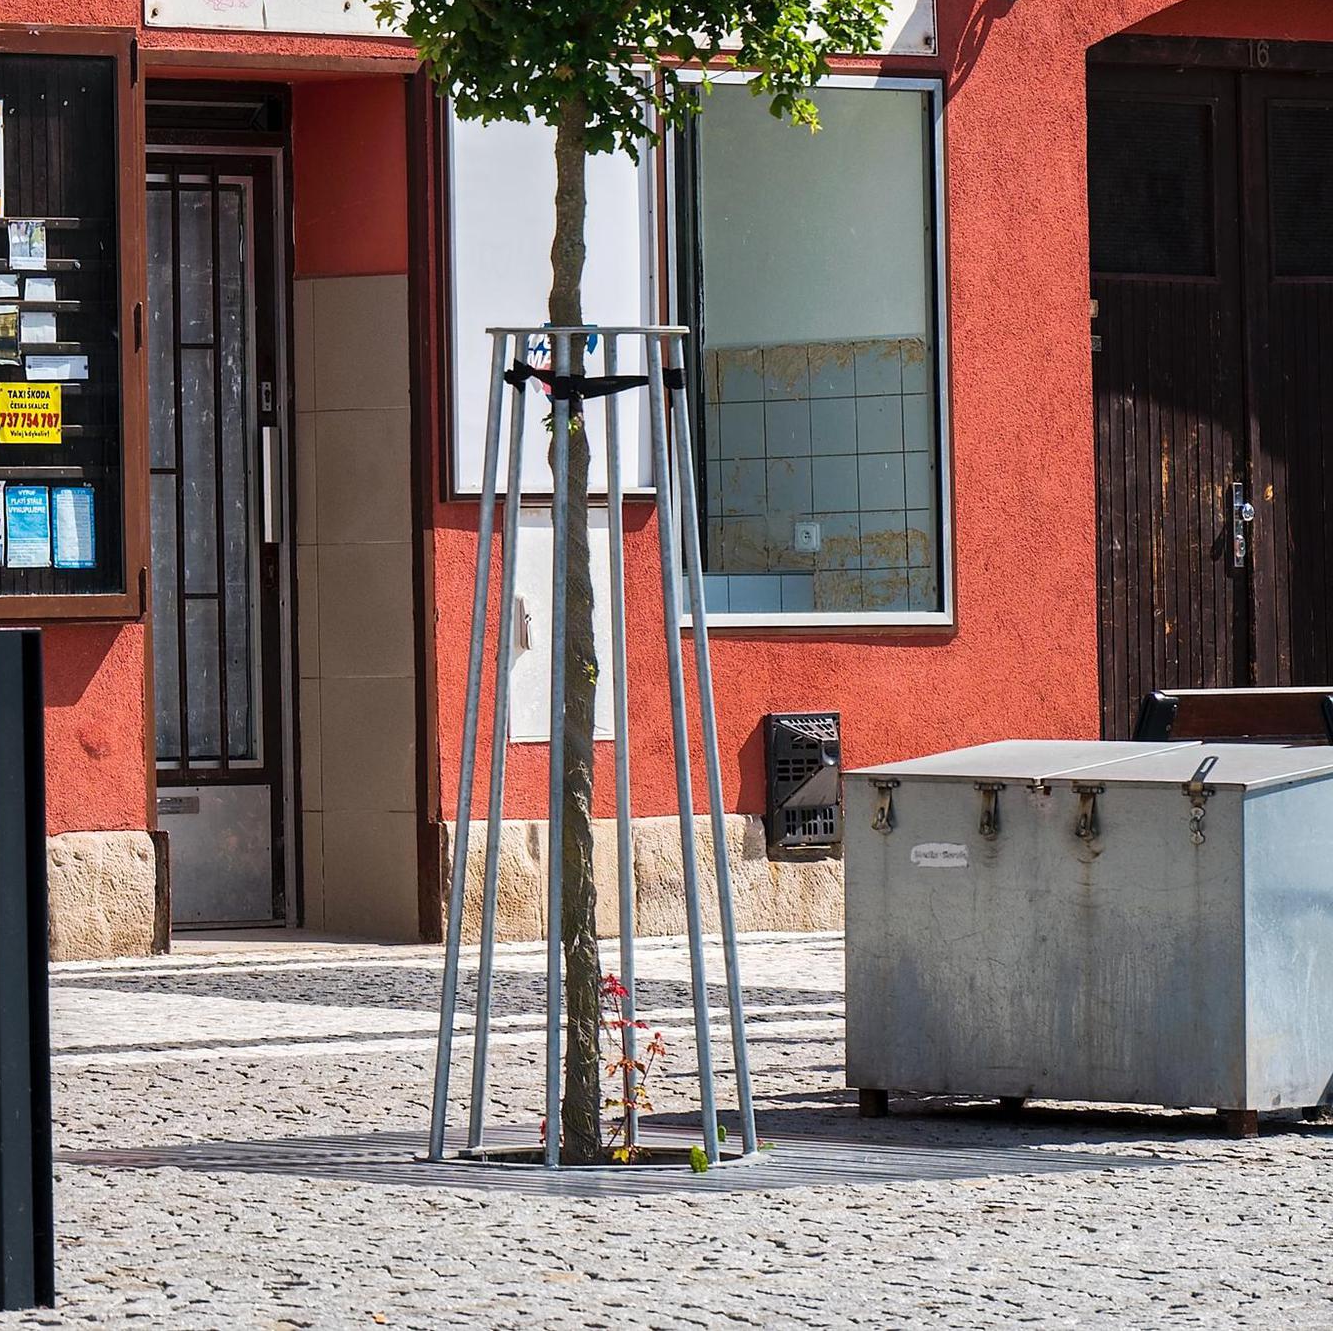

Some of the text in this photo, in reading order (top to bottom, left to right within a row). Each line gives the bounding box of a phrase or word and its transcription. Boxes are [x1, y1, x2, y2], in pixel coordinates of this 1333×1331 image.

[7, 387, 51, 399] TAXI ŠKODA
[0, 412, 19, 428] 737
